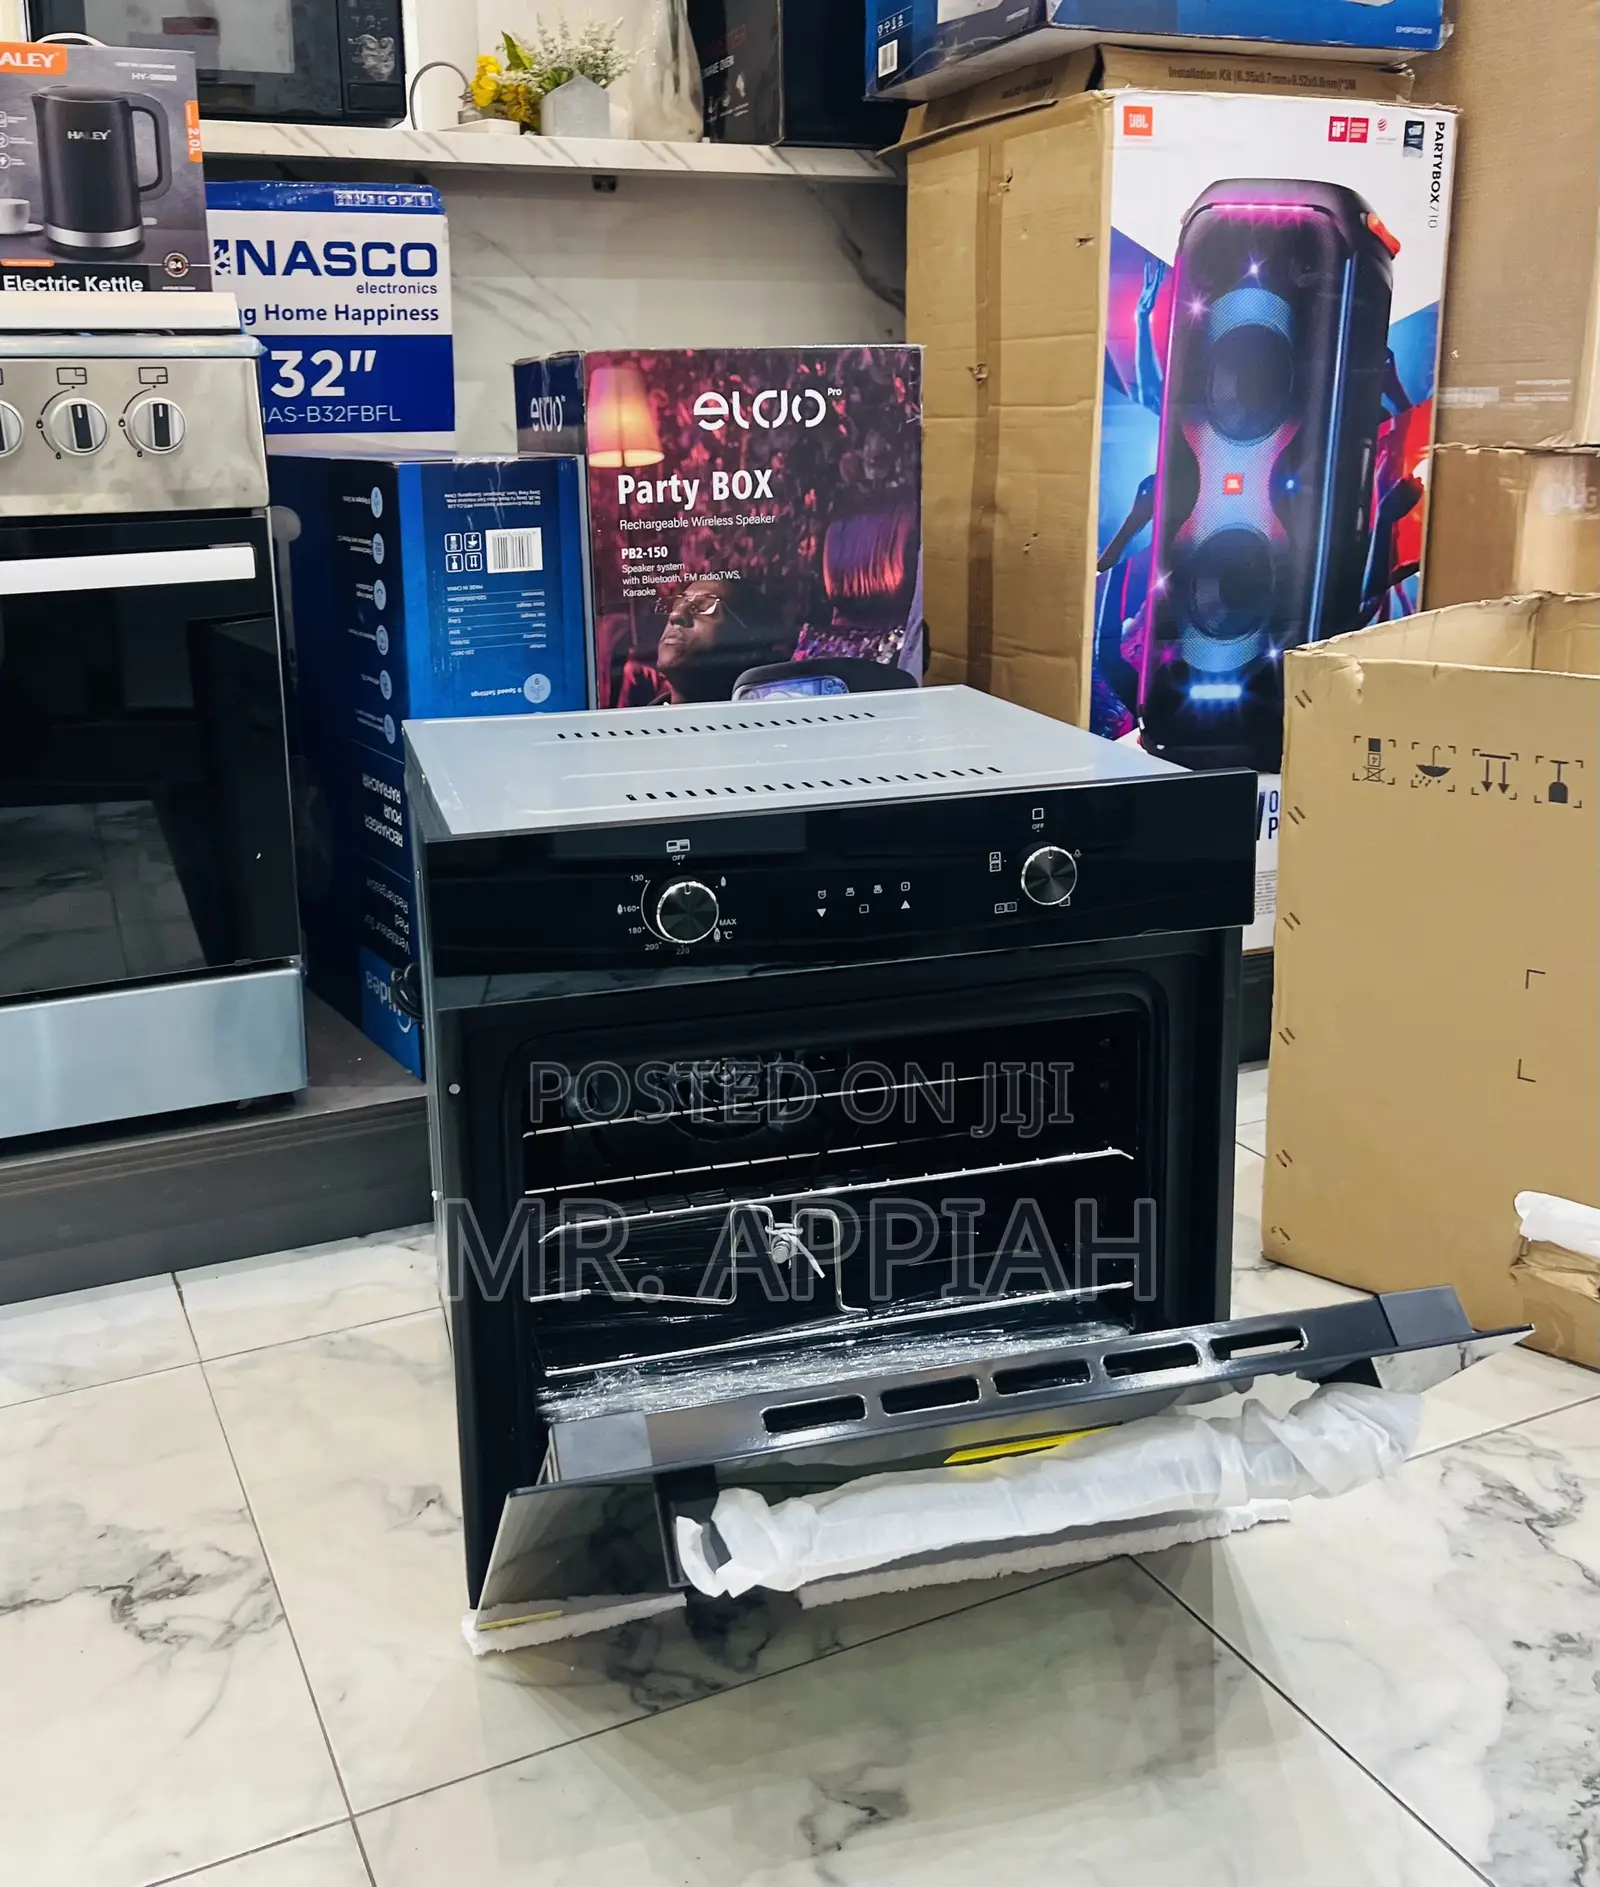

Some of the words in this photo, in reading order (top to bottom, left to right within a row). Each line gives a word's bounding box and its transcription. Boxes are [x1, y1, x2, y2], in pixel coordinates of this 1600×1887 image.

[1168, 65, 1217, 81] Installation
[1219, 68, 1231, 82] Kit
[1129, 113, 1149, 128] JBL
[235, 239, 439, 278] NASCO
[3, 275, 80, 292] Electric
[84, 276, 144, 292] Kettle
[356, 282, 438, 294] electronics
[265, 304, 327, 321] Home
[335, 304, 439, 326] Happiness
[270, 350, 377, 398] 32"
[827, 387, 842, 396] Pro
[617, 474, 700, 511] Party
[712, 469, 774, 501] BOX
[620, 518, 689, 531] Rechargeable
[691, 516, 734, 527] Wireless
[735, 515, 775, 528] Speaker
[621, 546, 668, 559] PB2-150
[622, 564, 655, 574] Speaker
[657, 563, 685, 573] system
[622, 576, 640, 585] with
[642, 574, 682, 585] Bluetooth,
[684, 573, 697, 581] FM
[623, 588, 656, 597] Karaoke
[384, 804, 403, 826] POUR
[364, 815, 403, 848] RECHARGER
[630, 874, 644, 882] 130
[622, 904, 637, 913] 160
[719, 918, 737, 926] MAX
[628, 926, 643, 935] 180
